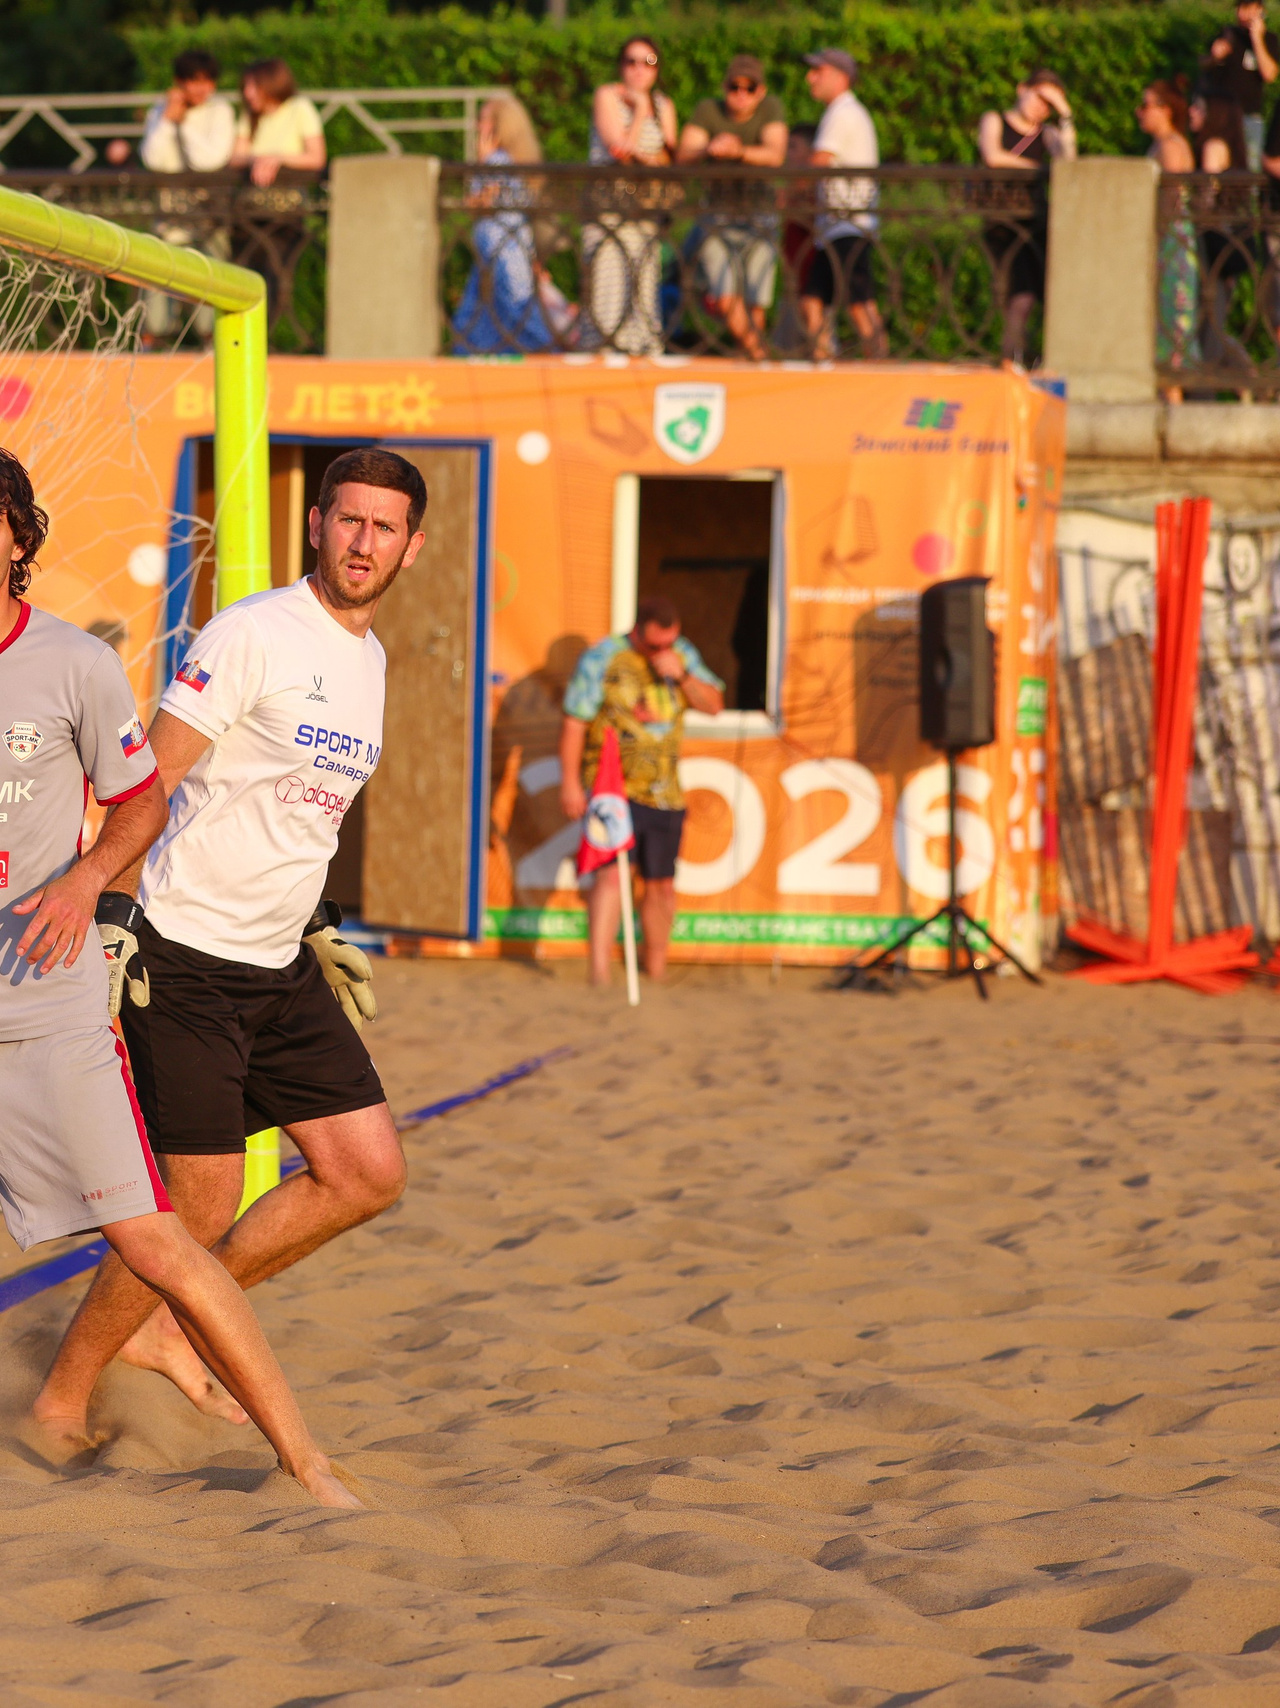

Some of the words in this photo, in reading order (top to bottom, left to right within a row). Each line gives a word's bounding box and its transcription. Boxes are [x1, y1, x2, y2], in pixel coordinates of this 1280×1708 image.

[305, 692, 328, 703] JÖGEL
[294, 723, 363, 759] SPORT
[365, 742, 381, 768] M
[313, 754, 370, 782] Самара
[303, 782, 354, 815] alageu
